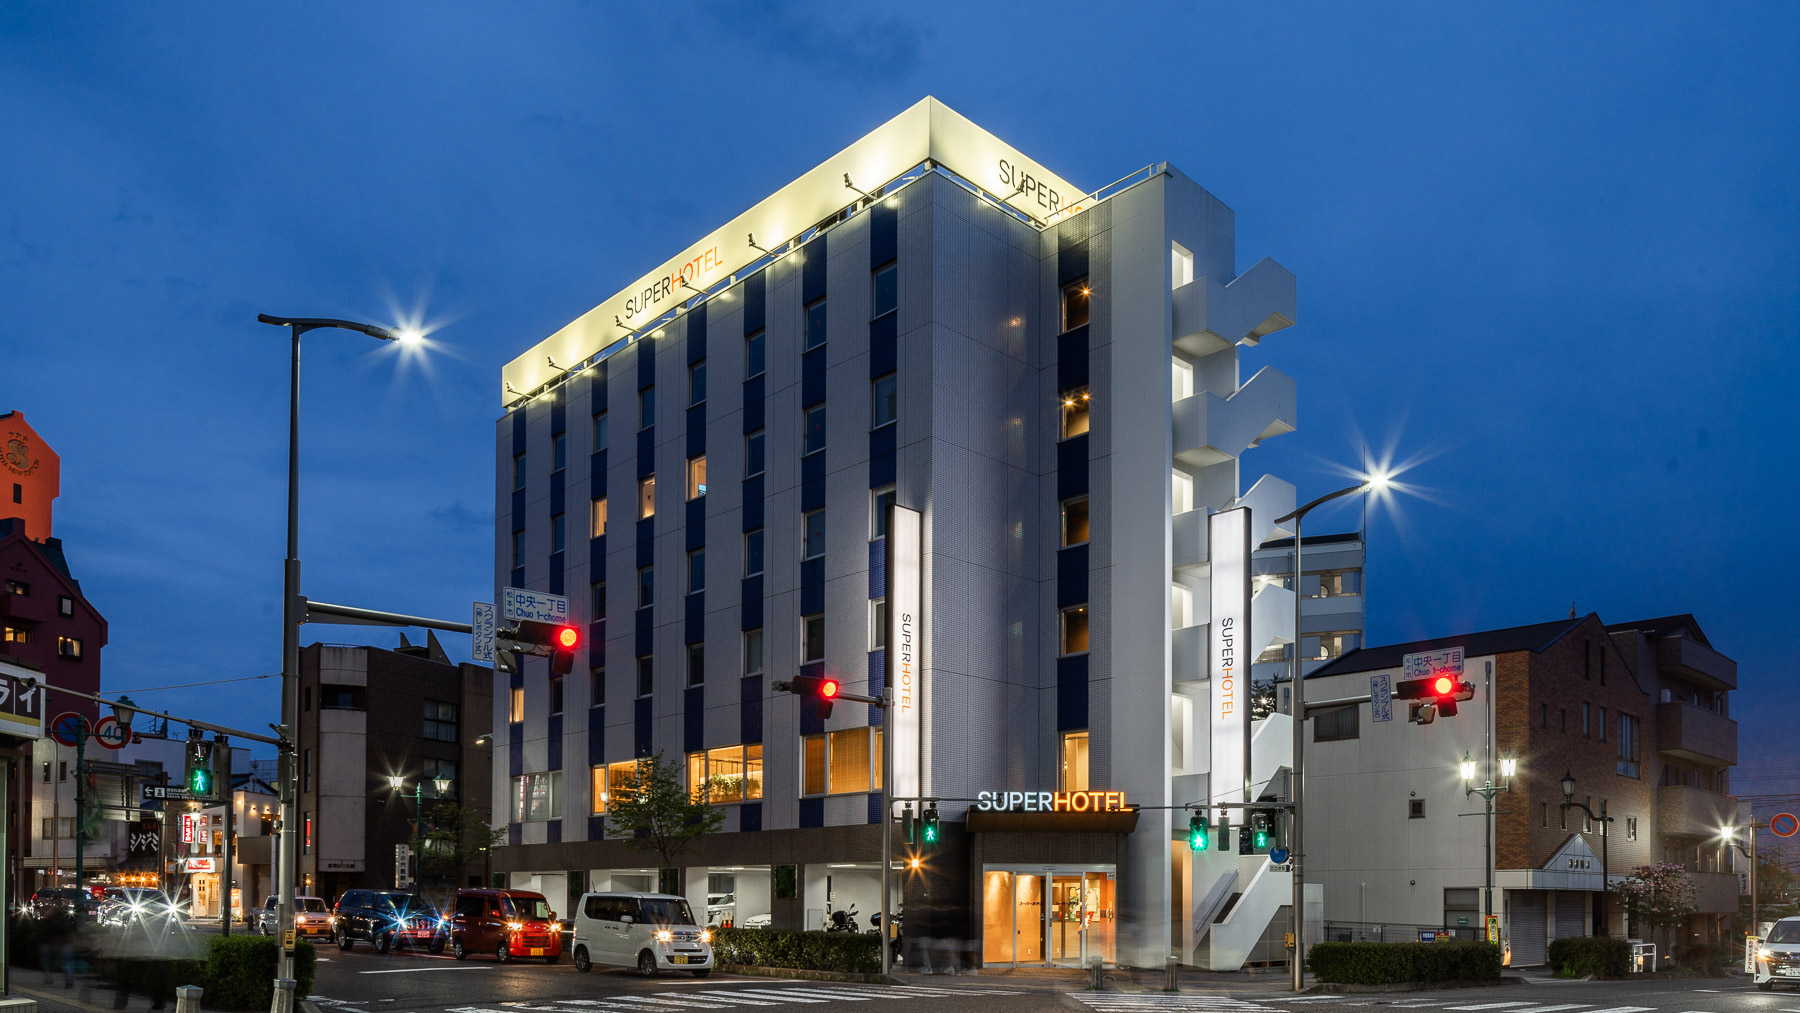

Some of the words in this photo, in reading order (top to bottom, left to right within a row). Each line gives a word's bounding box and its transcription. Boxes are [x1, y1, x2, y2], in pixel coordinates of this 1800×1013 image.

[626, 246, 723, 319] SUPERHOTEL
[515, 594, 566, 613] 中央一丁目
[515, 607, 534, 618] Chuo
[536, 611, 567, 624] 1-chome
[902, 613, 912, 713] SUPERHOTEL
[1222, 617, 1234, 720] SUPERHOTEL
[1413, 651, 1461, 668] 中央一丁目
[1413, 668, 1430, 677] Chuo
[1432, 665, 1461, 674] 1-chome
[103, 725, 122, 740] 40
[977, 791, 1133, 812] SUPERHOTEL
